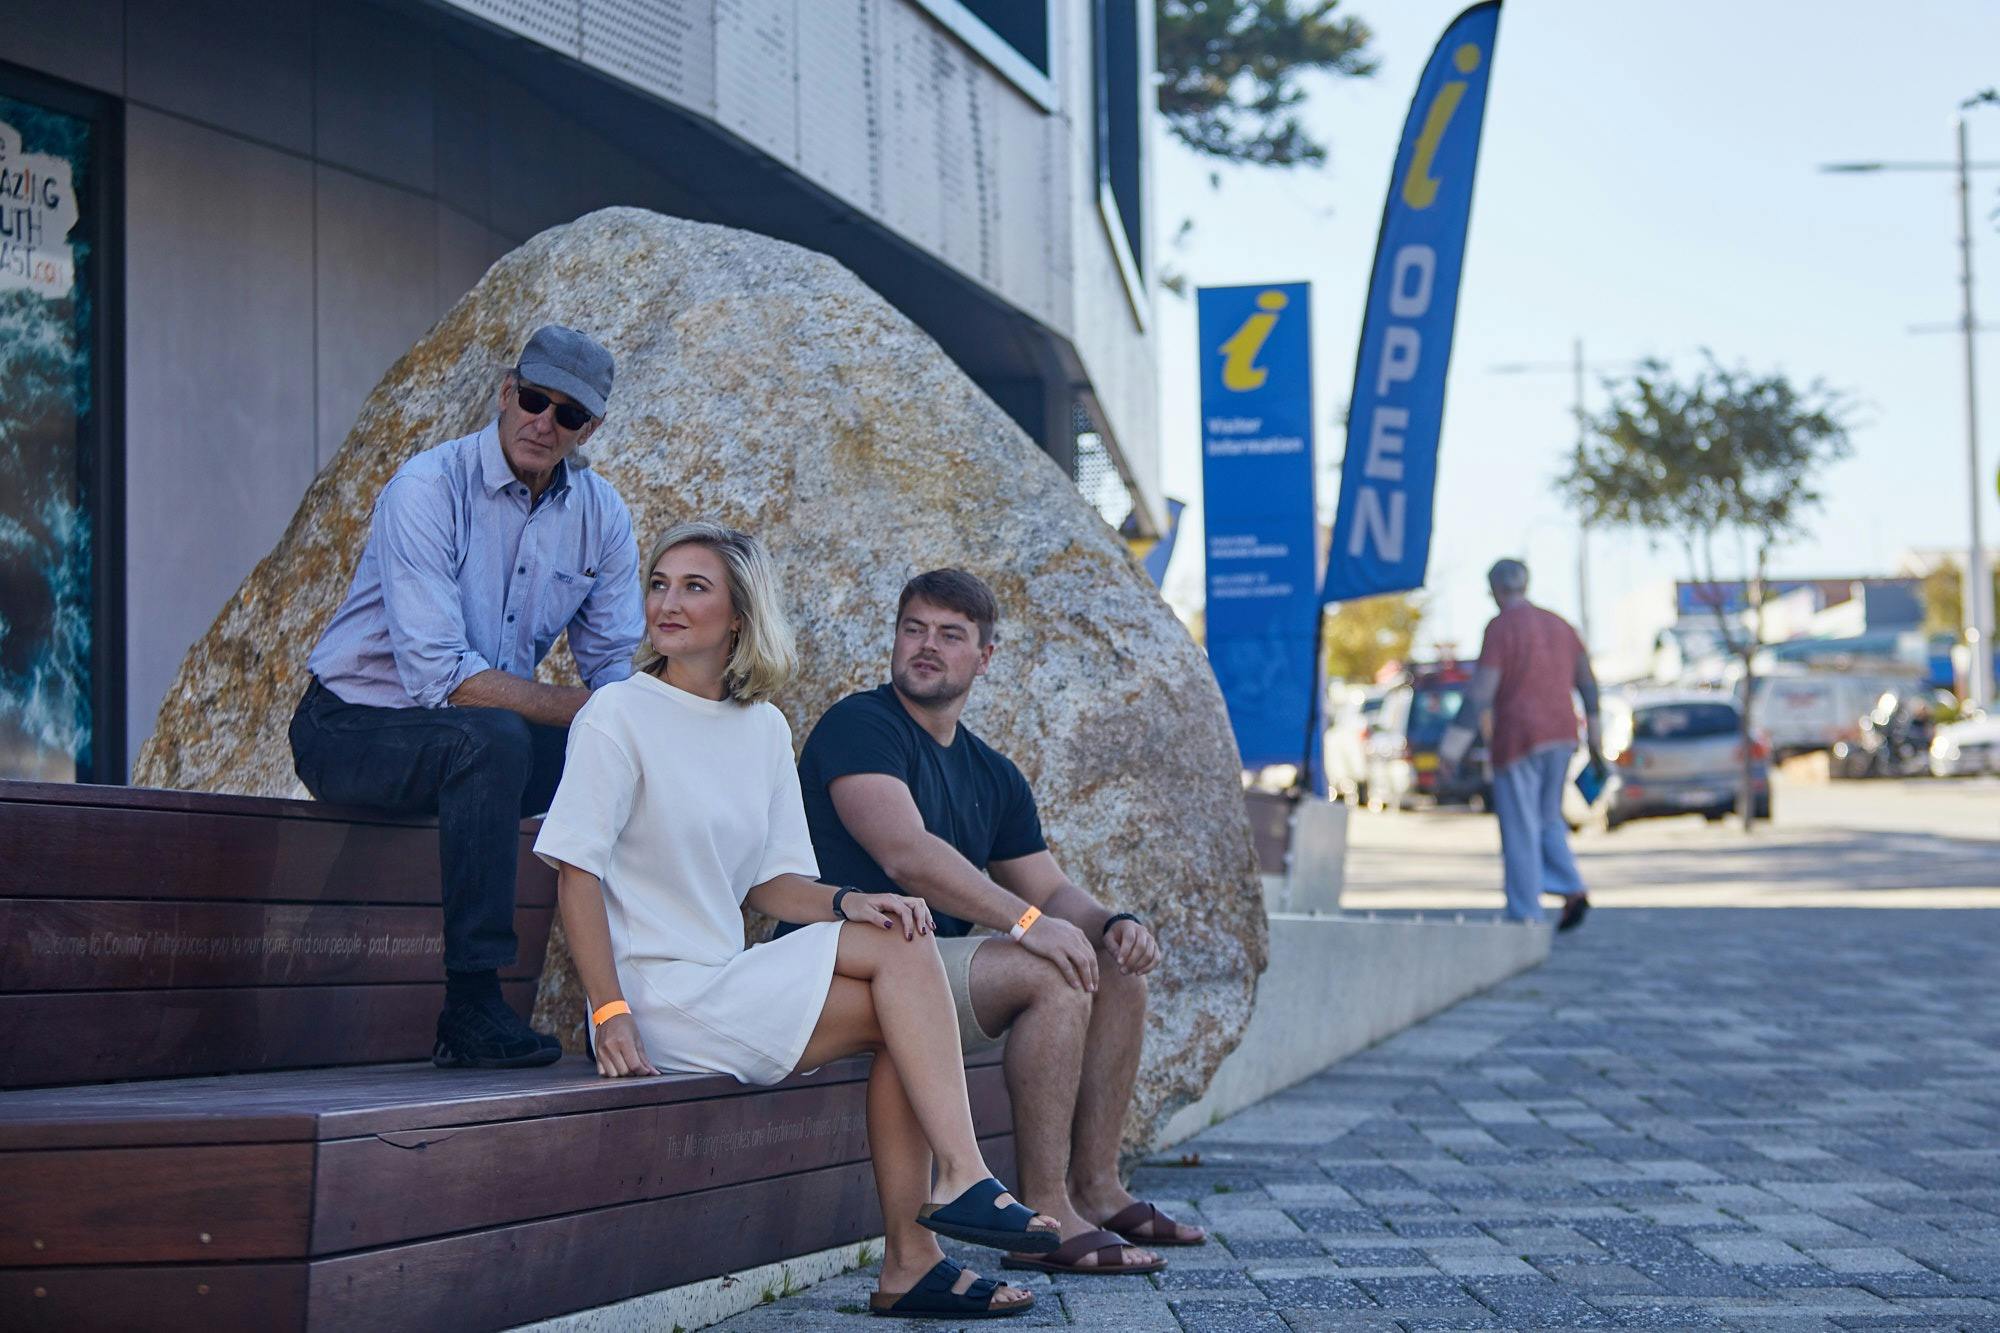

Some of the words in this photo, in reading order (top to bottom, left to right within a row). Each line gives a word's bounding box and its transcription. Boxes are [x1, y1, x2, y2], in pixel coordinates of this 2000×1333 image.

[0, 204, 42, 246] UTH
[1347, 244, 1437, 563] OPEN
[292, 931, 311, 954] and
[312, 937, 328, 954] our
[329, 931, 360, 959] people
[391, 933, 424, 958] present
[425, 931, 443, 954] and
[767, 1117, 804, 1143] Traditional
